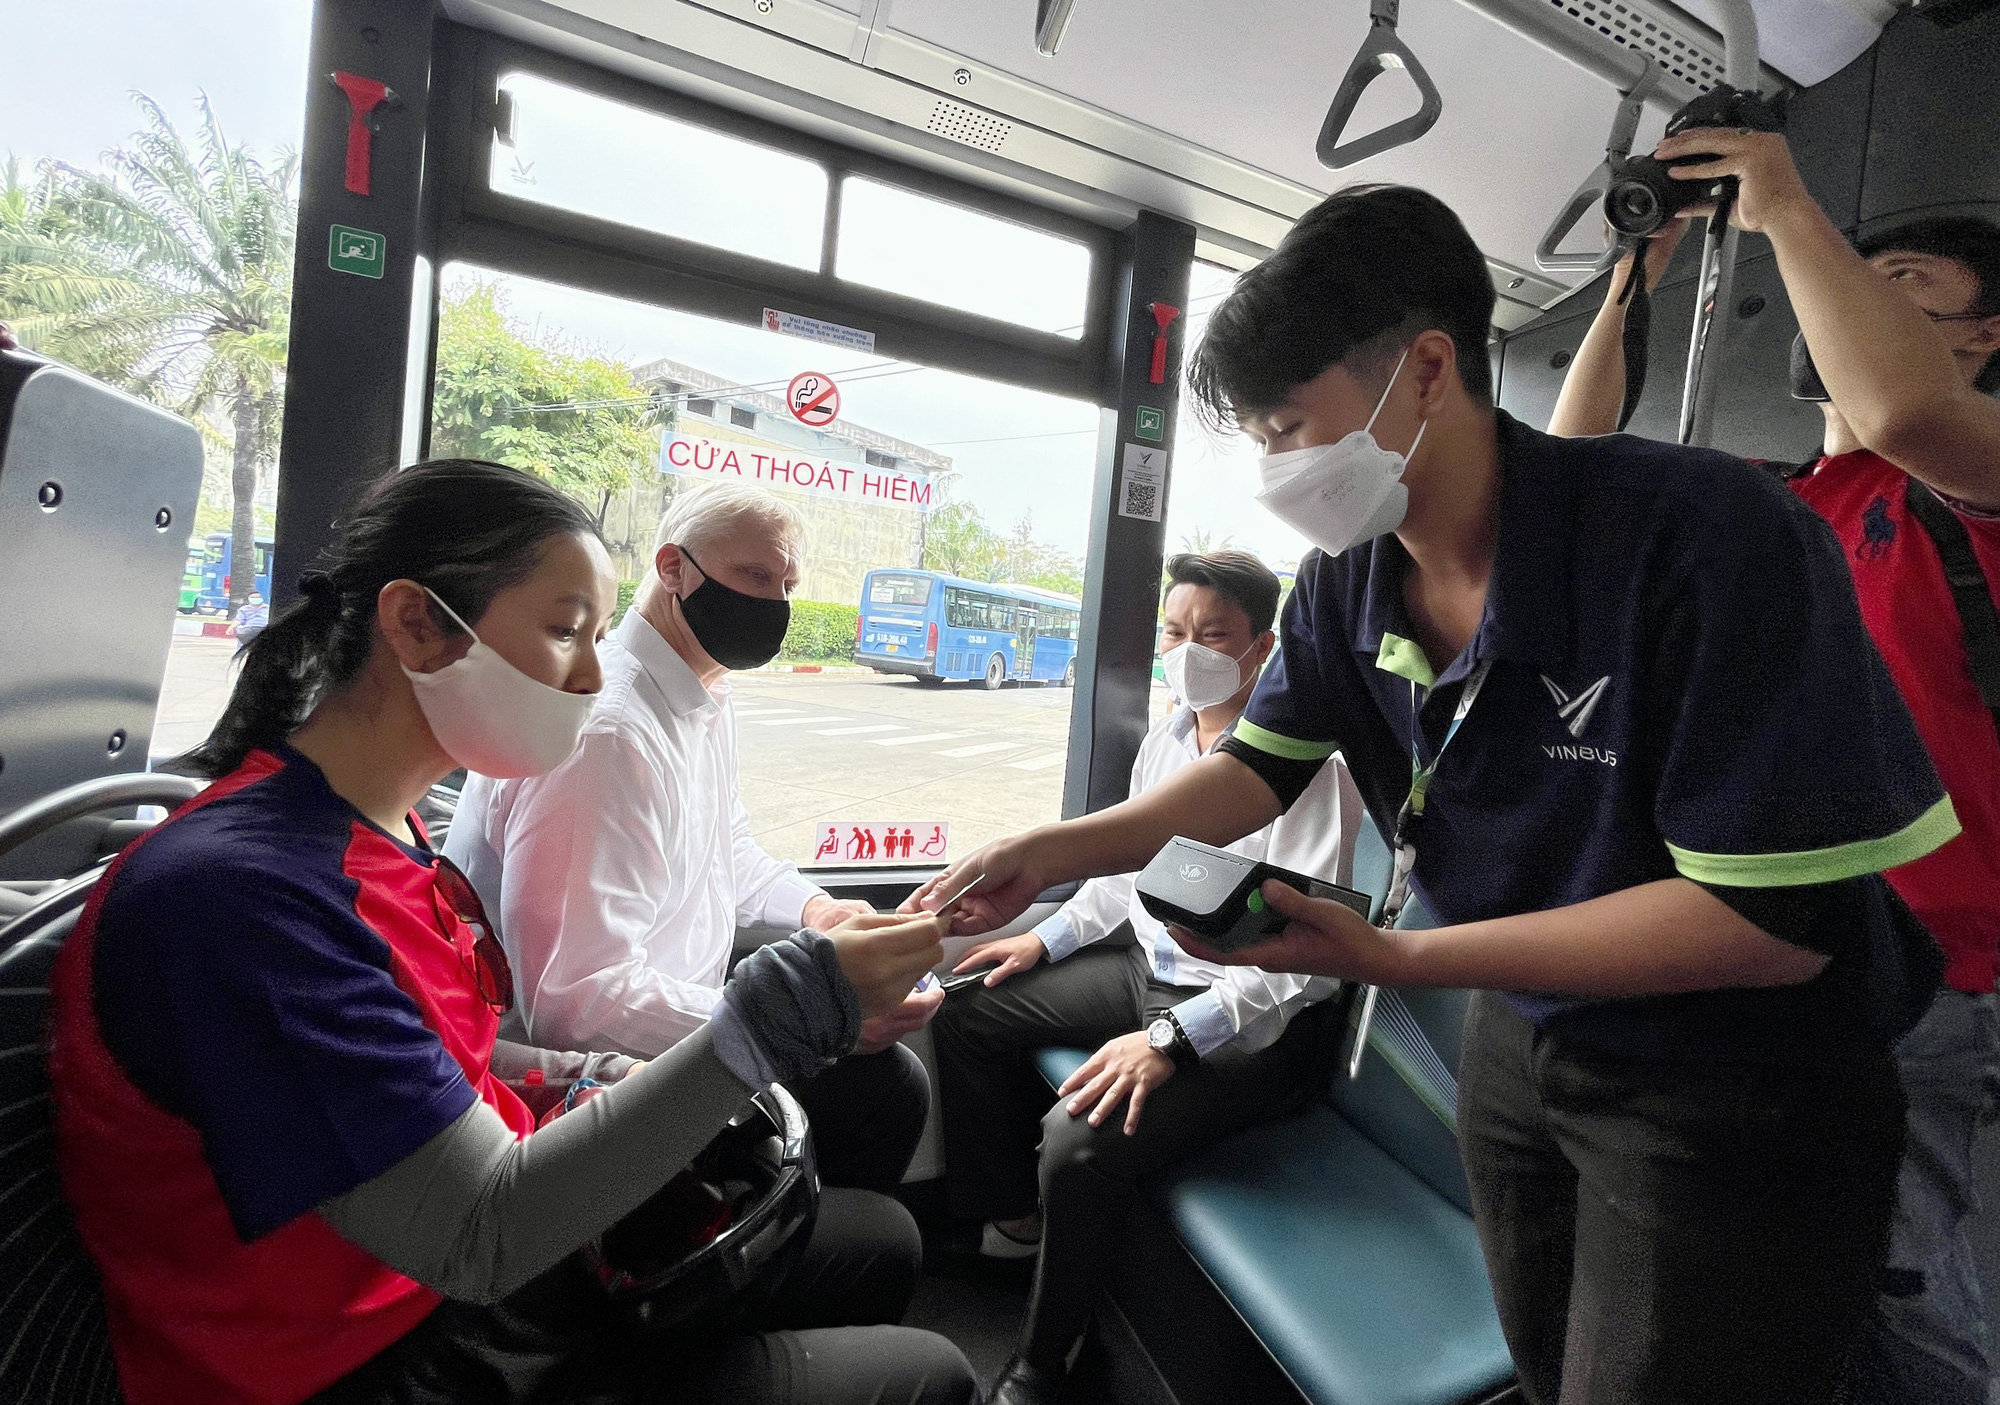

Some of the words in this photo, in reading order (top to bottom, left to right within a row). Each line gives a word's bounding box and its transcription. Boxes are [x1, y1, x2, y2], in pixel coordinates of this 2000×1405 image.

[790, 316, 801, 324] Vui
[668, 439, 742, 476] CỬA
[750, 454, 855, 493] THOÁT
[862, 473, 932, 505] HIỂM
[1541, 745, 1617, 767] VINBUS
